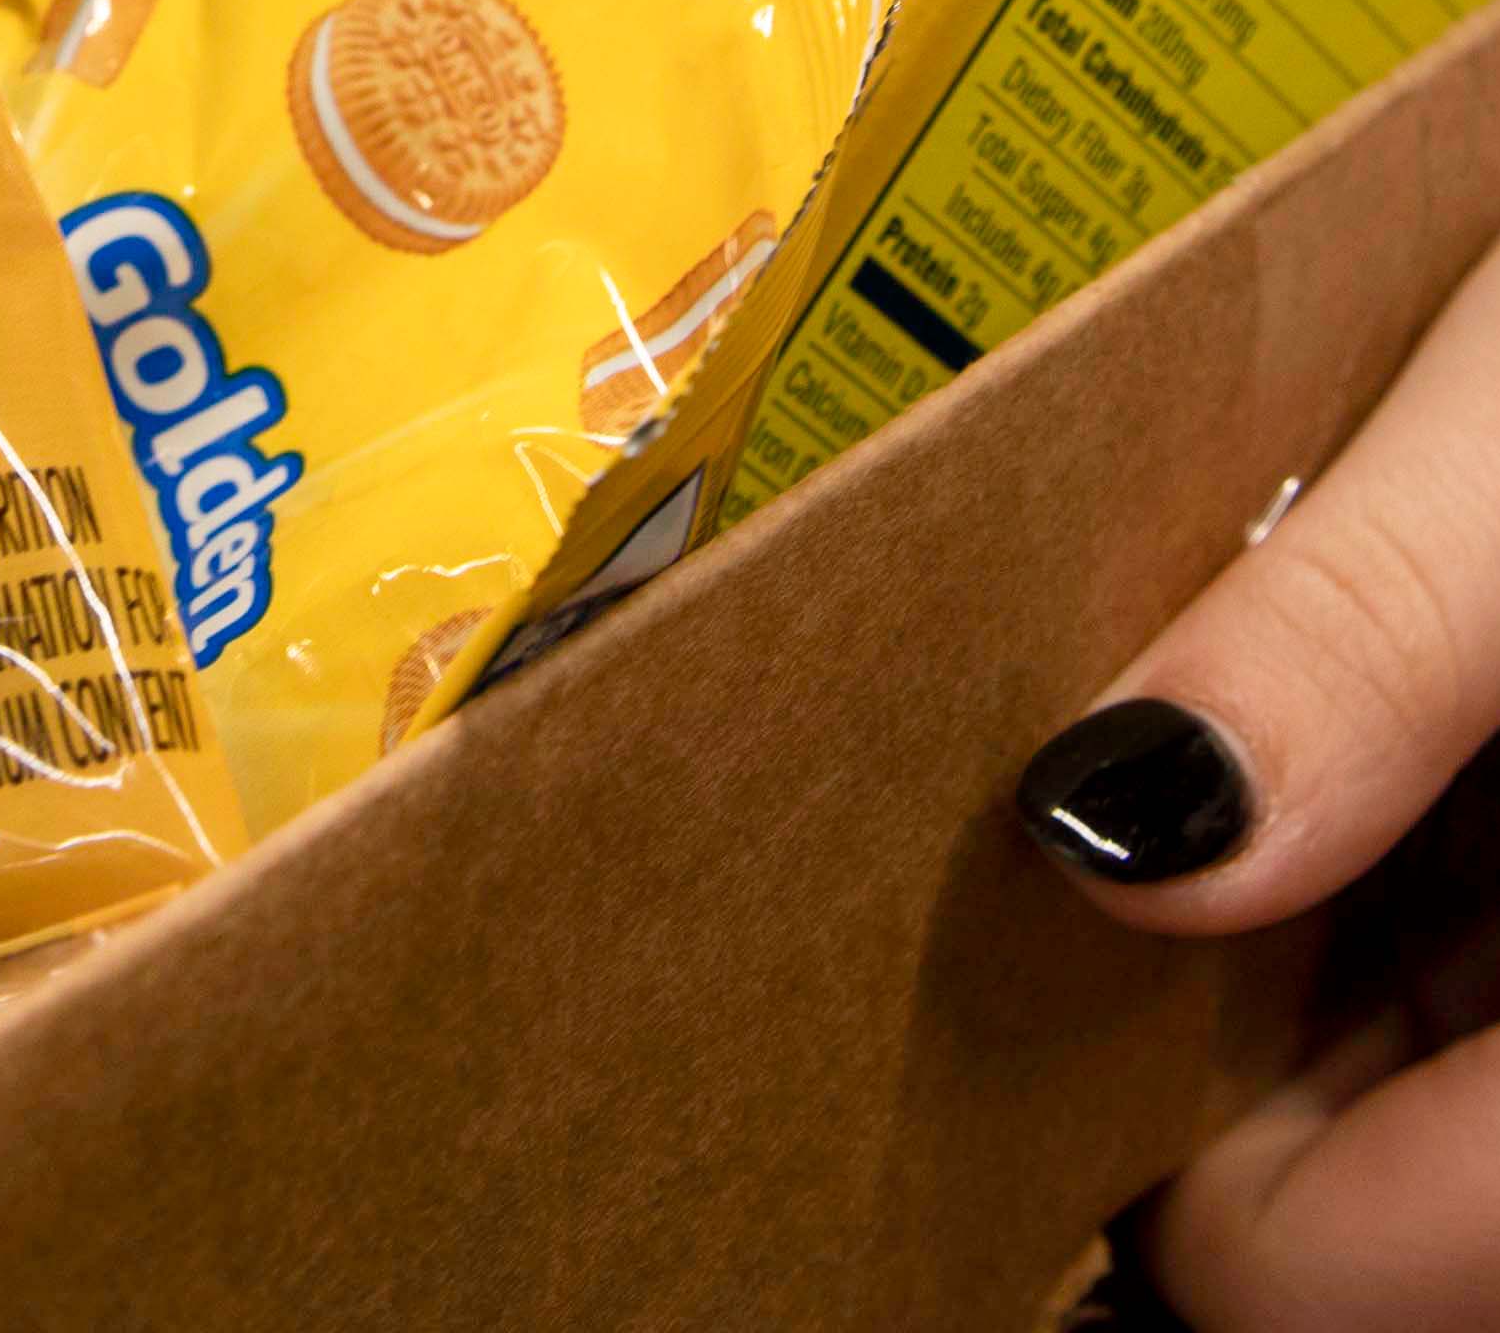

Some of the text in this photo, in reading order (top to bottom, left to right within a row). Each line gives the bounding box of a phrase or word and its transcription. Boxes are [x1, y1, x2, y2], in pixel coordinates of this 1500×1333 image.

[1001, 58, 1073, 151] Dietary
[1076, 123, 1124, 178] Fiber
[1083, 43, 1207, 171] Carbohydrate
[947, 188, 1030, 275] Includes
[968, 114, 1025, 177] Total
[1019, 163, 1088, 245] Sugars
[879, 217, 958, 298] Protein
[955, 283, 988, 337] 2g
[824, 305, 903, 387] Vitamin
[65, 206, 290, 652] Golden
[746, 419, 796, 474] Iron
[55, 669, 201, 771] CONTENT
